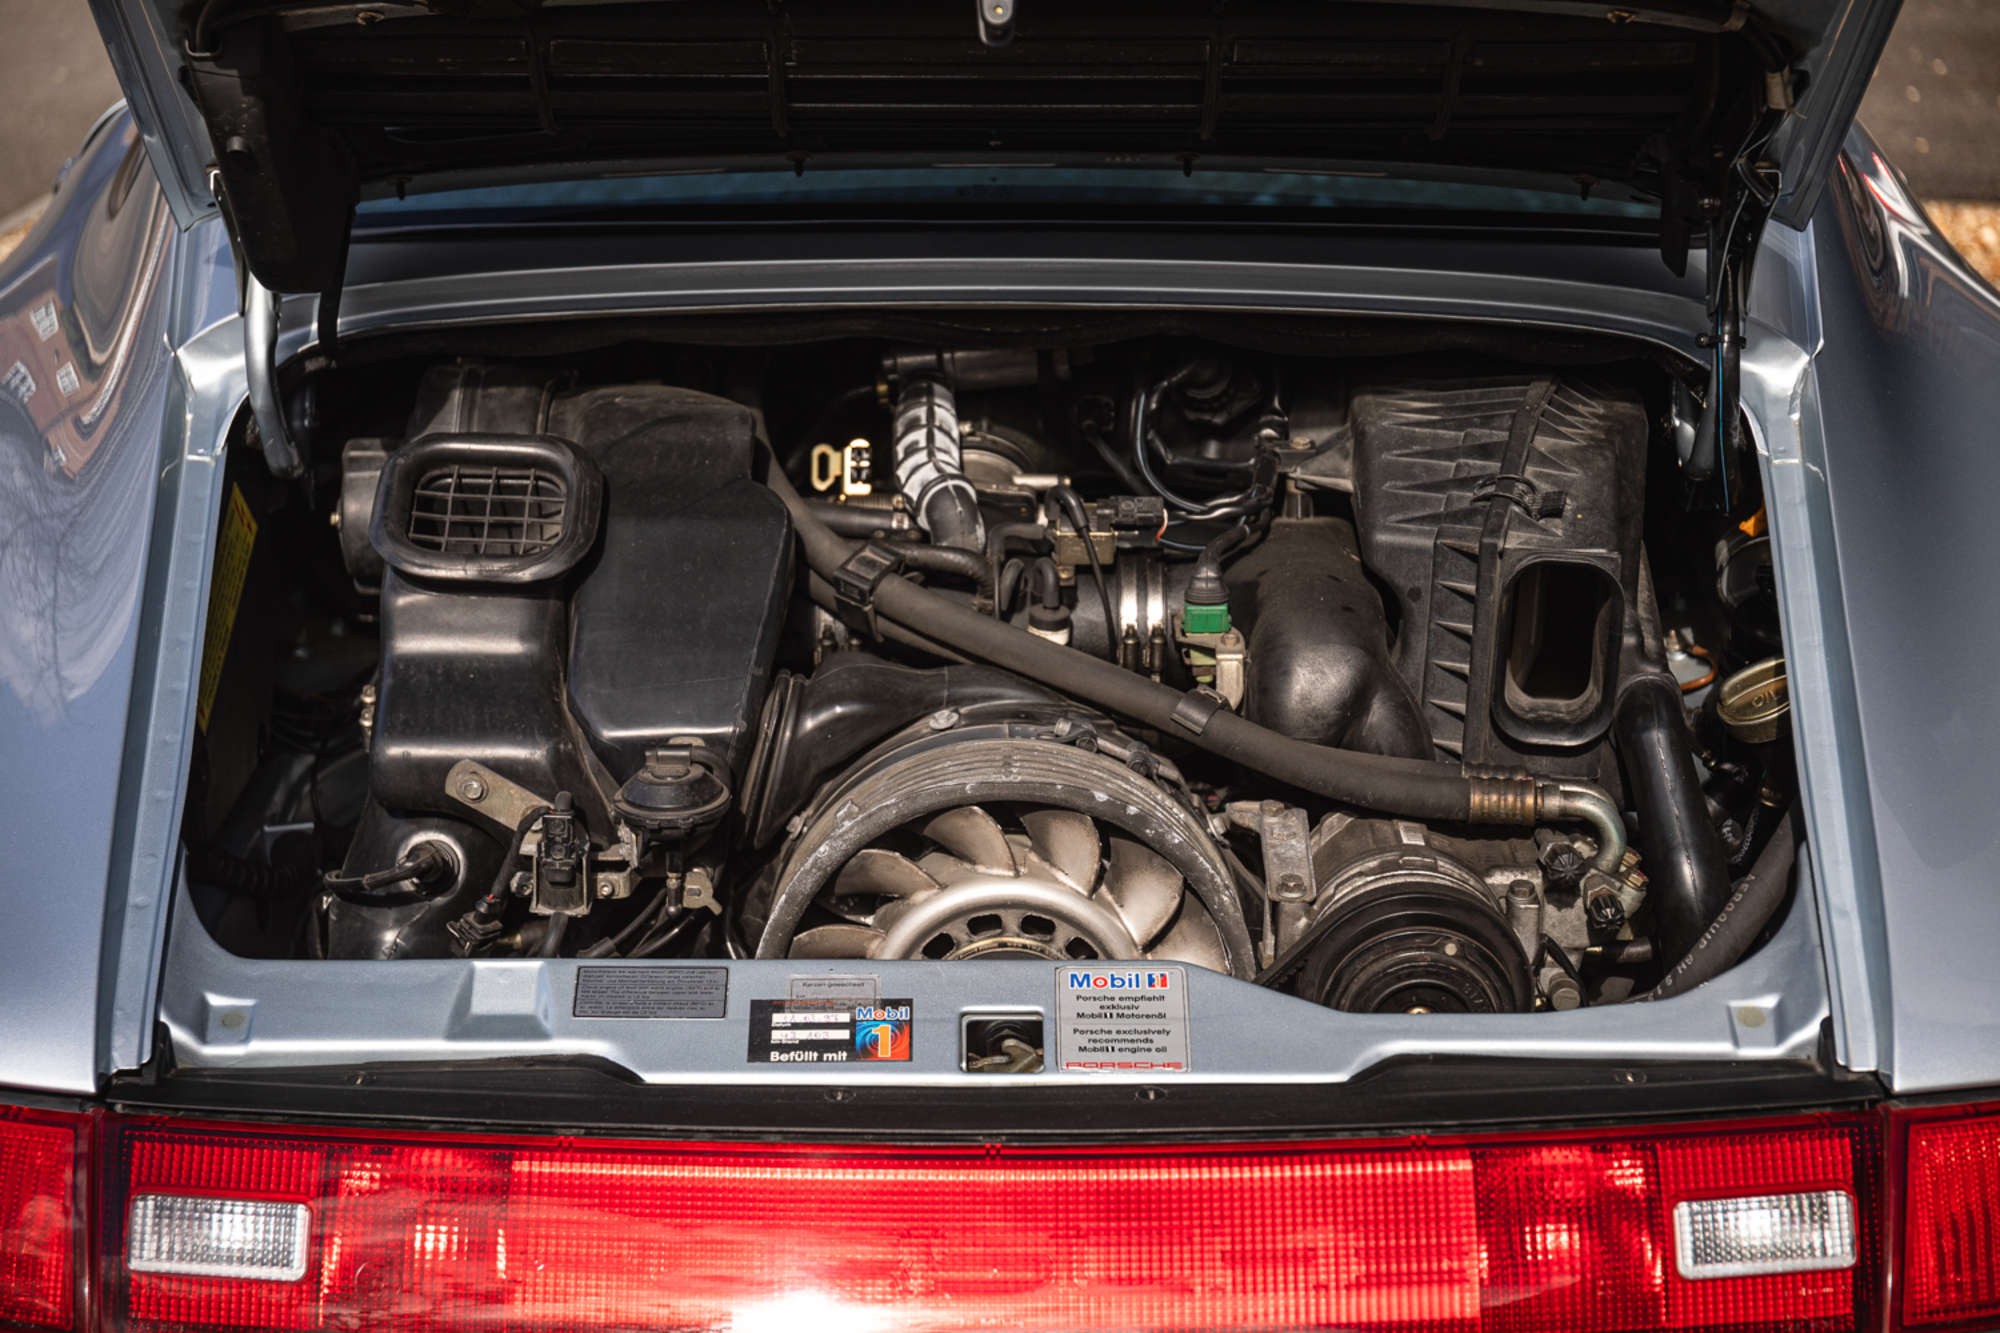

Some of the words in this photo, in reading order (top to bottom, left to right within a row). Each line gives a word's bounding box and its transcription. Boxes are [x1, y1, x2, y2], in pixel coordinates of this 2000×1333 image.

[1069, 972, 1140, 989] Mobil
[1118, 995, 1165, 1003] empfiehlt
[855, 1006, 910, 1021] Mobil
[1115, 1028, 1172, 1036] exclusively
[871, 1023, 893, 1058] 1
[1118, 1046, 1153, 1054] engine
[770, 1051, 819, 1062] Befüllt
[823, 1051, 848, 1062] mit
[1065, 1061, 1183, 1070] PORSCHE
